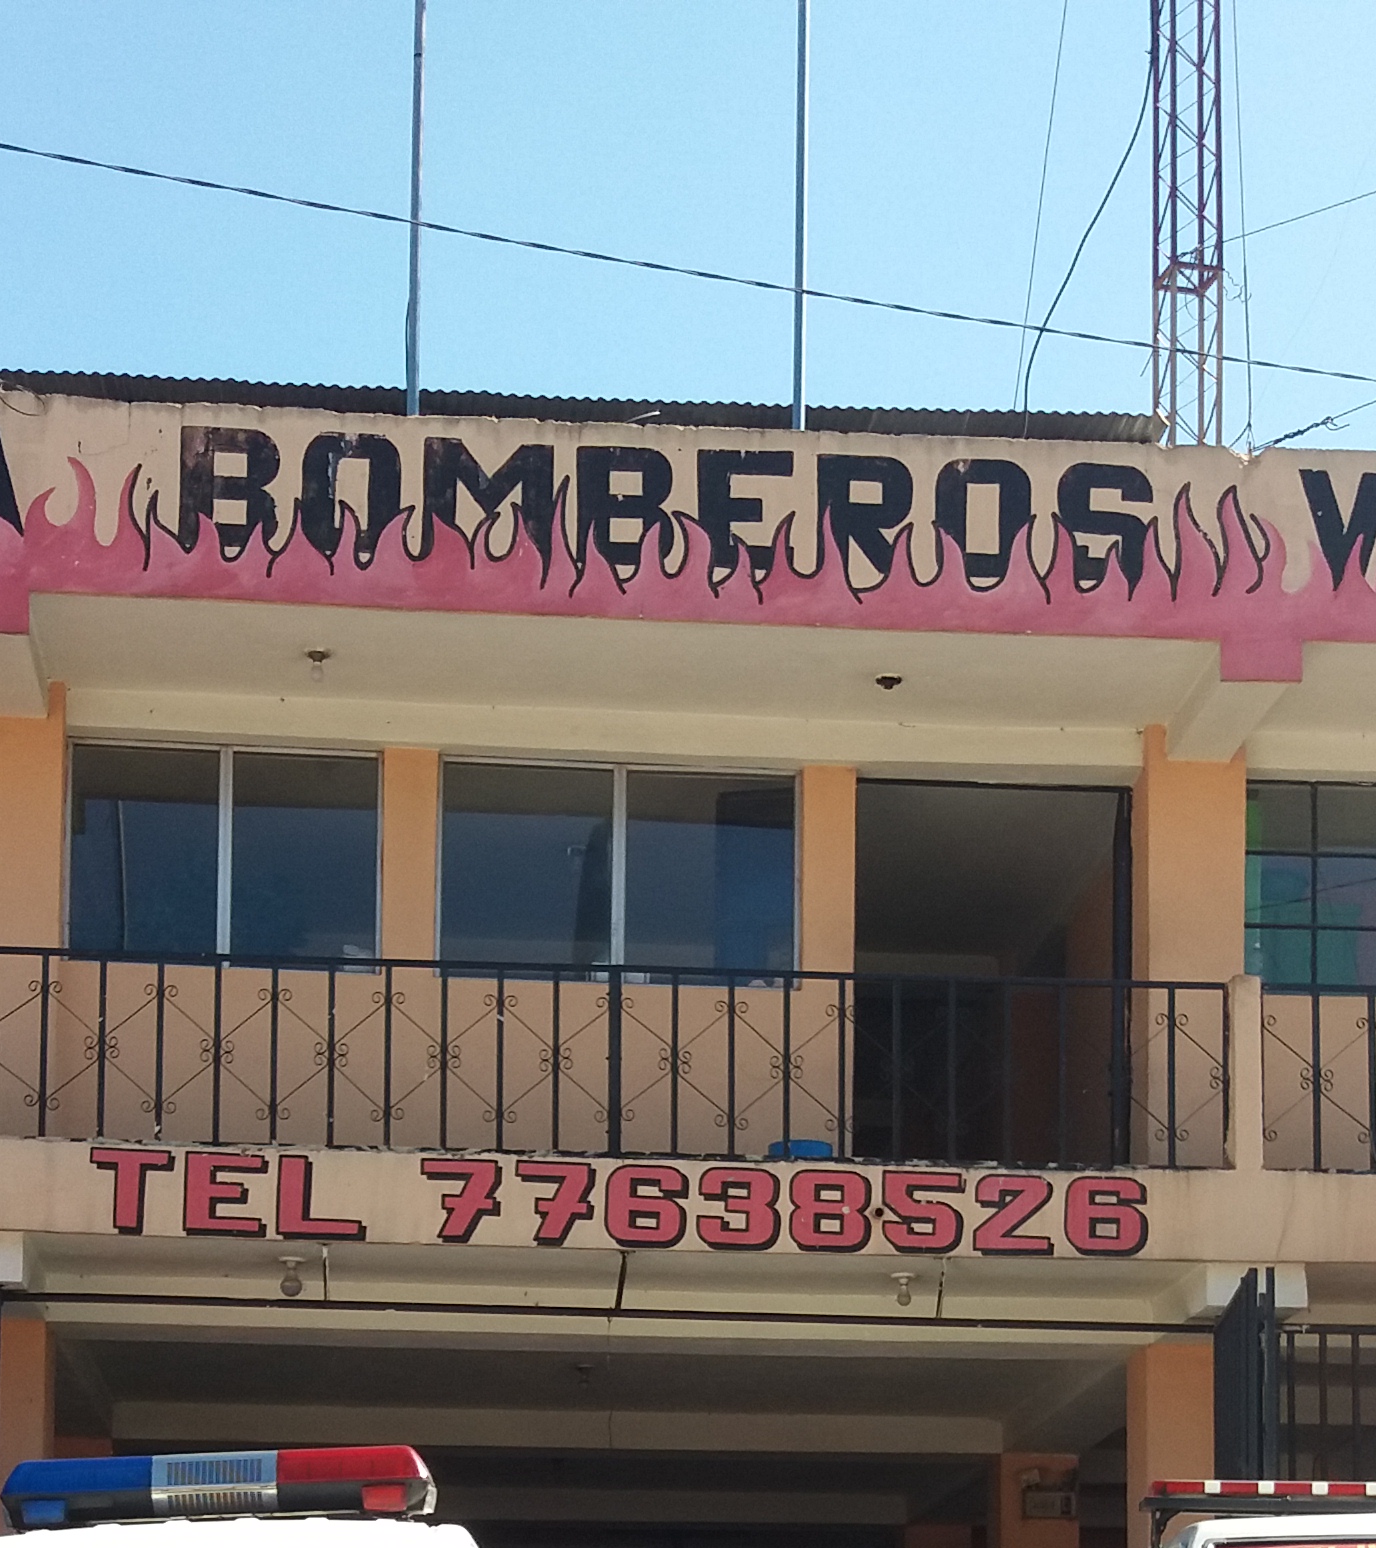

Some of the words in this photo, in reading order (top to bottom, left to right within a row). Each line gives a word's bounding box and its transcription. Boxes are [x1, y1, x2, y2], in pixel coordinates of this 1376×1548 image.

[176, 425, 1158, 592] BOMBEROS
[90, 1147, 366, 1240] TEL
[424, 1157, 1148, 1256] 77638526
